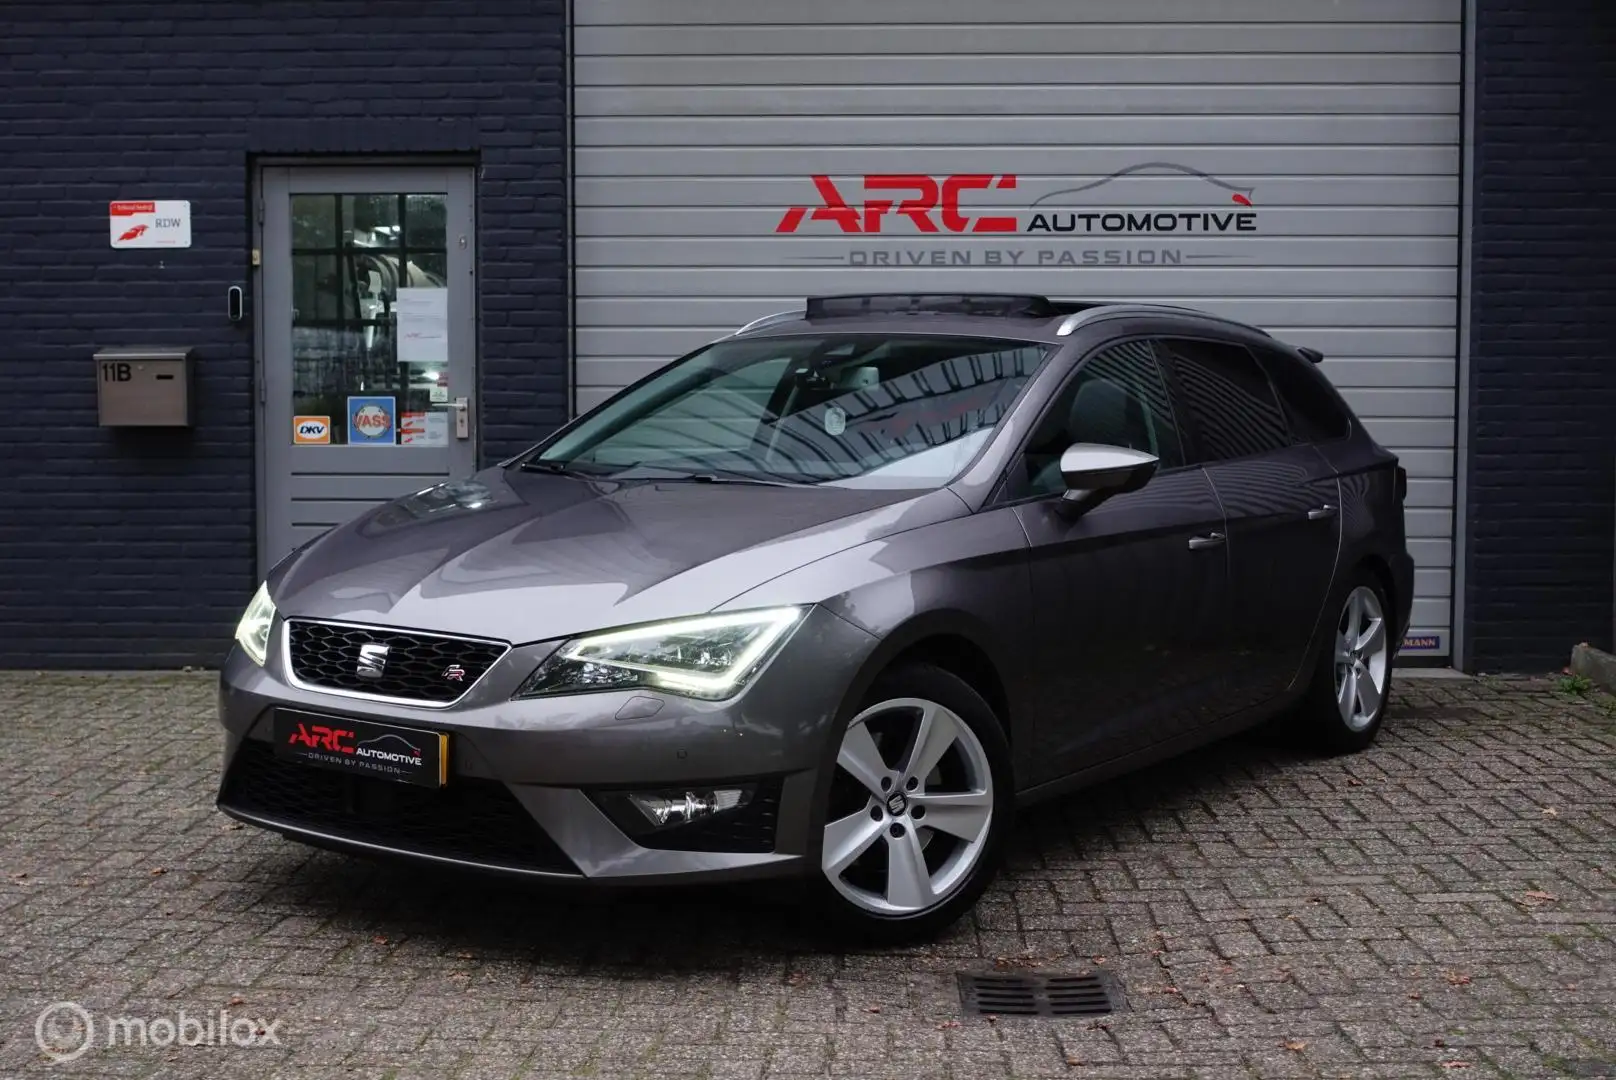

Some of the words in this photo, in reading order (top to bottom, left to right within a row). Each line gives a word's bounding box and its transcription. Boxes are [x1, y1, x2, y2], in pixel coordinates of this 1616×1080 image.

[776, 174, 1017, 233] ARC
[1027, 213, 1257, 232] AUTOMOTIVE
[155, 218, 181, 229] RDW
[850, 250, 972, 265] DRIVEN
[984, 250, 1024, 265] BY
[1038, 249, 1181, 265] PASSION
[102, 362, 132, 382] 11B
[299, 425, 325, 434] DKV
[1403, 638, 1435, 647] MANN
[288, 723, 355, 754] ARC
[356, 747, 422, 766] AUTOMOTIVE
[308, 752, 342, 764] DRIVEN
[344, 758, 356, 767] BY
[359, 761, 401, 774] PASSION
